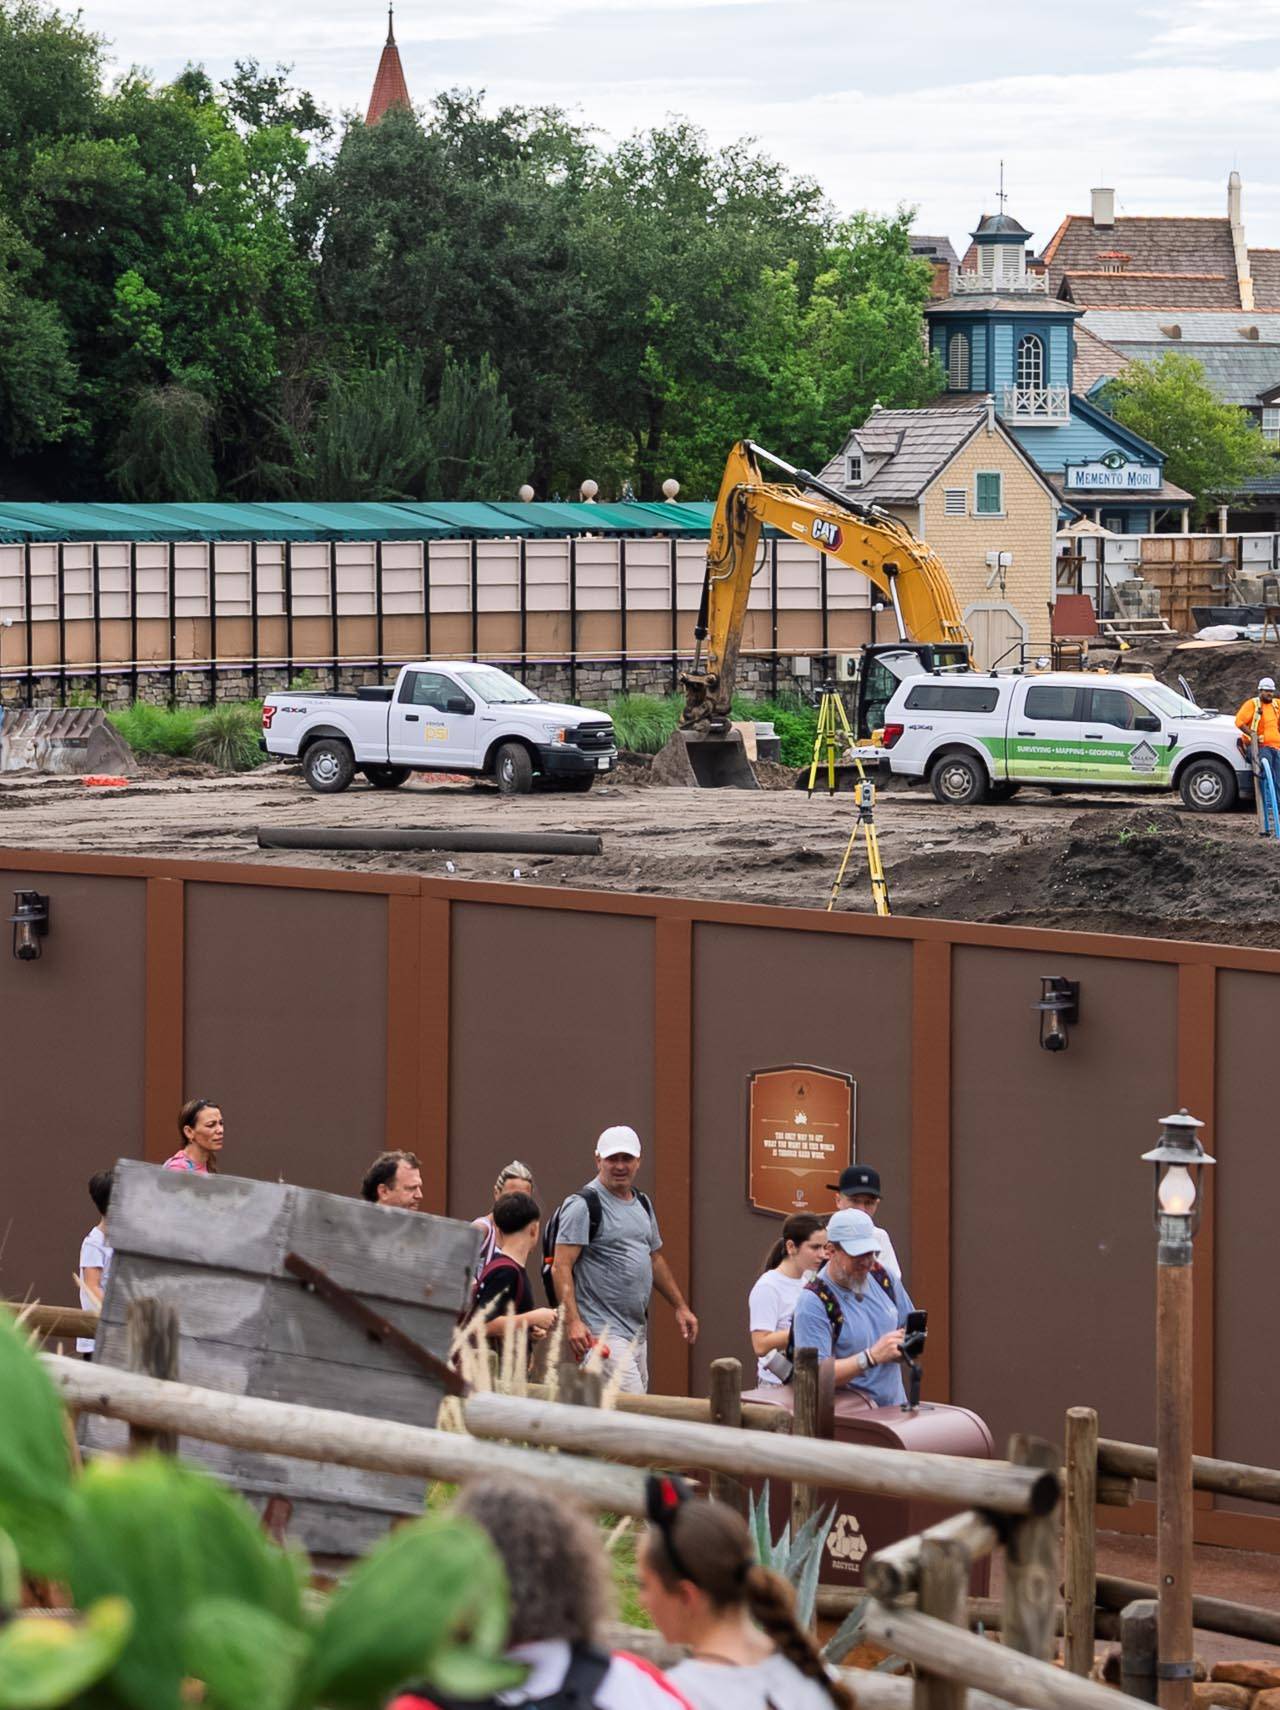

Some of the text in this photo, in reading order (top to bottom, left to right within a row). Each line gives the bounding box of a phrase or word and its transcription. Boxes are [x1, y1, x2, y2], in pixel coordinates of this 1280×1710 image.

[1076, 471, 1152, 486] MEMENTO MORI
[812, 518, 838, 545] CAT
[1017, 745, 1125, 757] SURVEYING MAPPING GEOSPATIAL
[832, 1560, 860, 1572] RECYCLE
